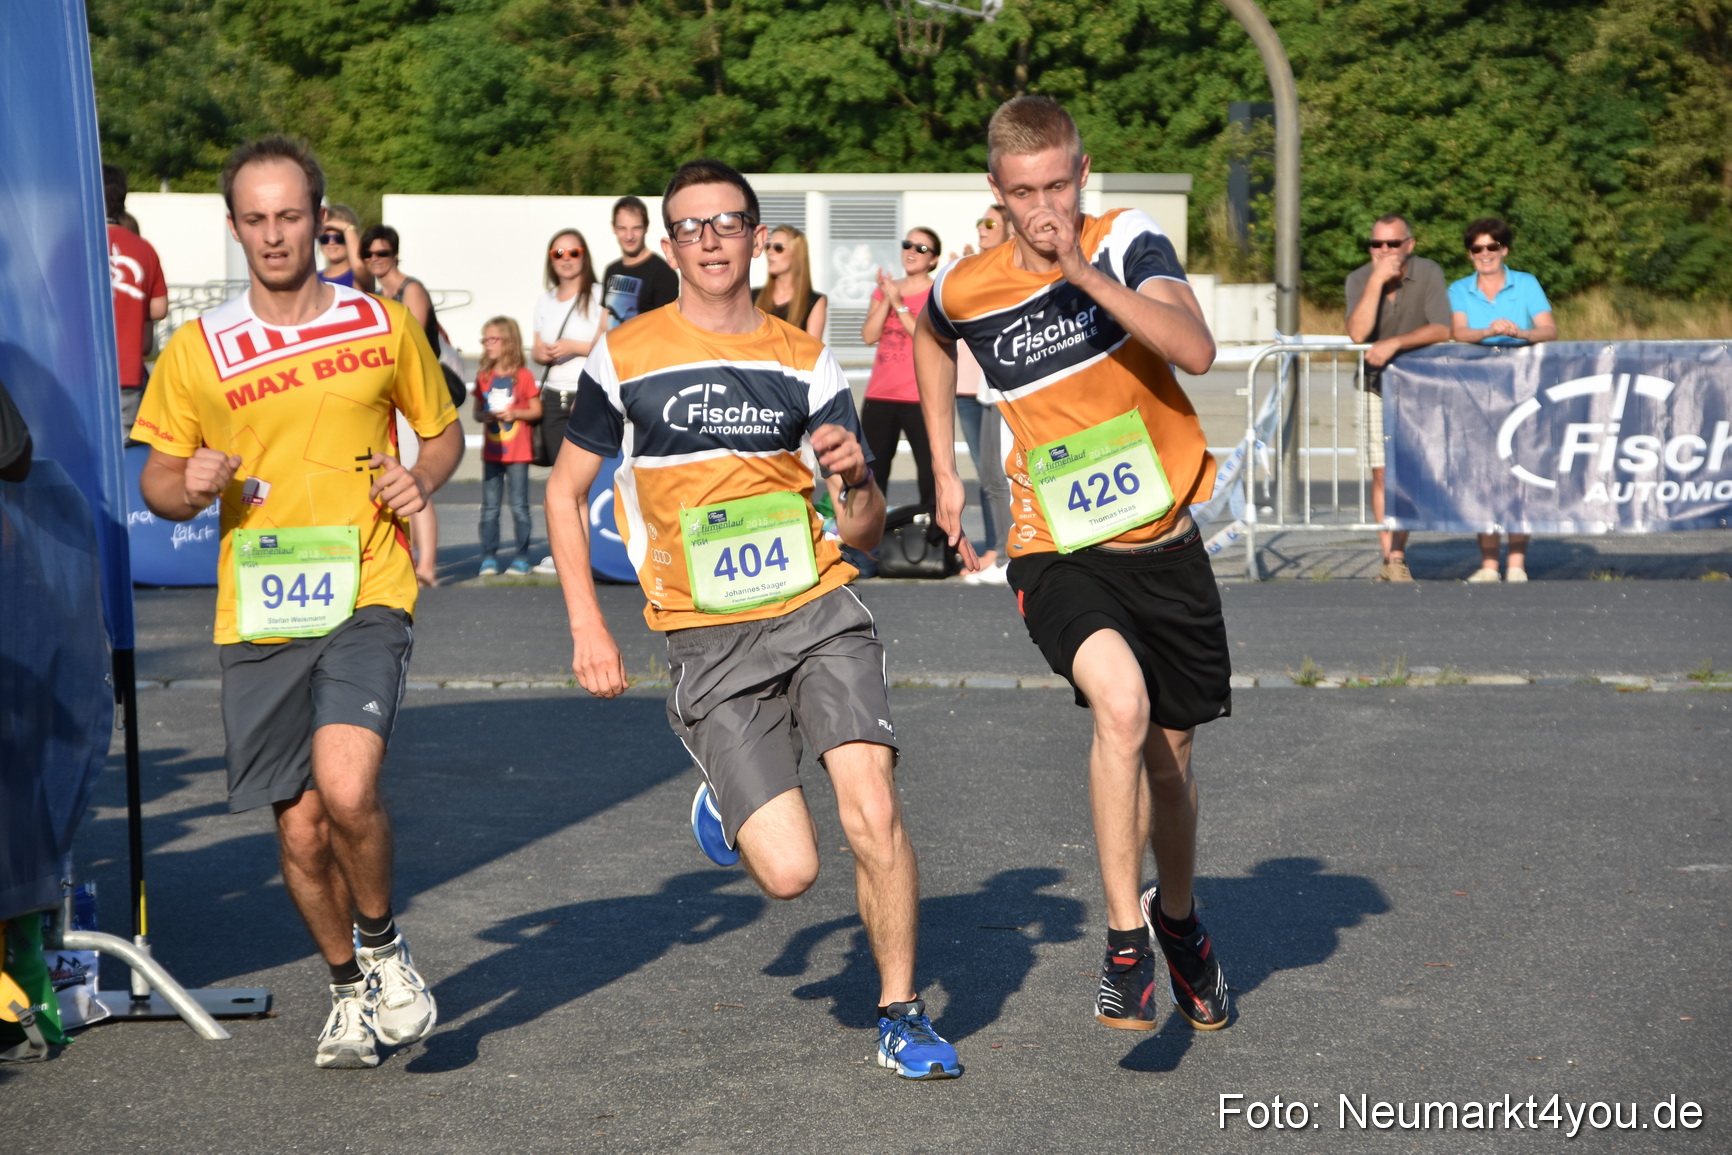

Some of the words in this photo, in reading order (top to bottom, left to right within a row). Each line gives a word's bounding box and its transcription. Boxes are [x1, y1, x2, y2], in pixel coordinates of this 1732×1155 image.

[1012, 305, 1097, 357] Fischer
[1025, 326, 1098, 366] AUTOMOBILE
[224, 367, 304, 411] MAX
[311, 348, 395, 380] BÖGL
[687, 401, 784, 424] Fischer
[699, 425, 780, 435] AUTOMOBILE
[1045, 449, 1086, 471] firmenlauf
[1067, 462, 1140, 512] 426
[1583, 480, 1732, 503] AUTOMO
[701, 517, 744, 533] firmenlauf
[1089, 511, 1118, 526] Thomas
[1118, 504, 1137, 515] Haas
[170, 522, 215, 550] fährt
[713, 537, 789, 581] 404
[261, 572, 334, 609] 944
[725, 586, 760, 598] Johannes
[761, 581, 787, 590] Saager
[267, 617, 290, 625] Stefan
